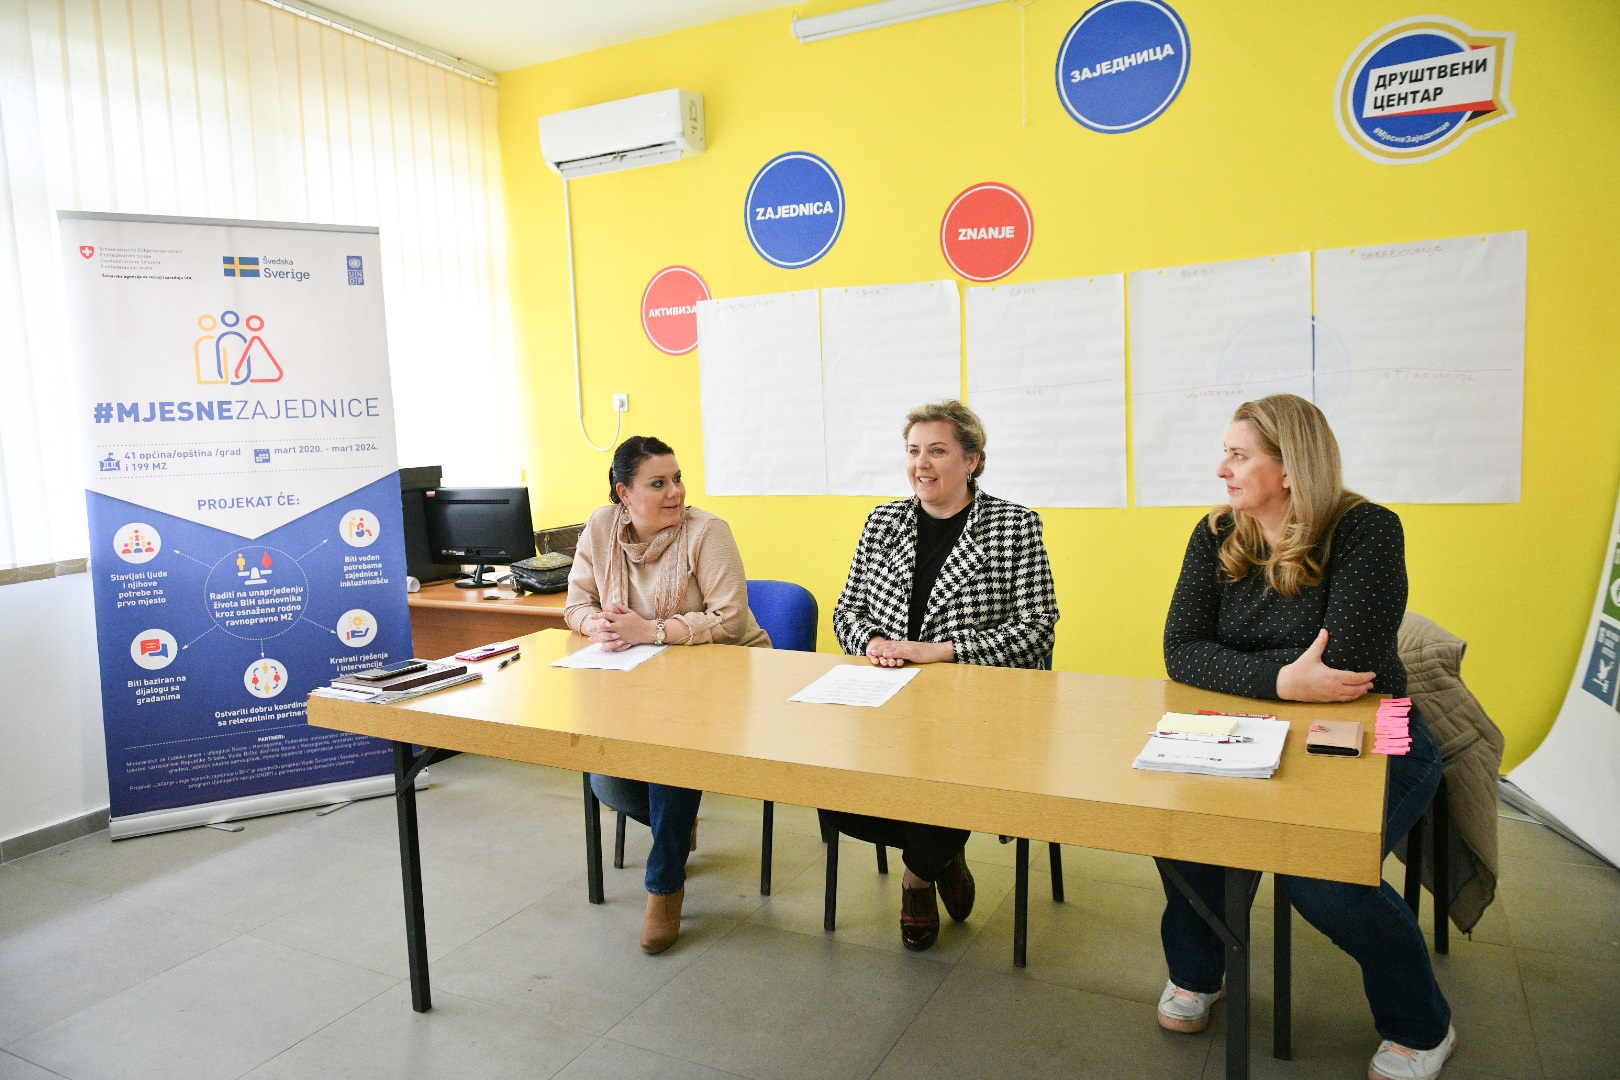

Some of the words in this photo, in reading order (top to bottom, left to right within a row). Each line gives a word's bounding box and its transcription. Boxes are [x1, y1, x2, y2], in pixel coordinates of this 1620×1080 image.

[1070, 43, 1175, 83] ЗАЈЕДНИЦА
[1374, 57, 1488, 91] ДРУШТВЕНИ
[1373, 87, 1444, 112] ЦЕНТАР
[755, 200, 834, 221] ZAJEDNICA
[957, 225, 1015, 241] ZNANJE
[262, 255, 294, 266] Švedska
[263, 268, 311, 282] Sverige
[93, 397, 380, 424] #MJESNEZAJEDNICE
[124, 451, 136, 460] 41
[139, 449, 213, 461] općina/opština
[214, 447, 242, 458] /grad
[274, 446, 296, 454] mart
[299, 445, 323, 454] 2020.
[331, 444, 353, 453] mart
[355, 443, 379, 452] 2024.
[131, 463, 149, 471] 199
[152, 462, 168, 471] MZ
[197, 495, 273, 511] PROJEKAT
[277, 491, 300, 507] ĆE:
[358, 554, 380, 562] vođen
[343, 563, 382, 572] potrebama
[110, 572, 146, 582] Stavljati
[147, 571, 168, 580] ljude
[345, 571, 378, 580] zajednice
[127, 580, 158, 590] njihove
[340, 577, 389, 588] inkluzivnošću
[118, 589, 151, 599] potrebe
[209, 591, 235, 600] Raditi
[249, 585, 304, 597] unaprjeđenju
[117, 600, 137, 609] prvo
[138, 597, 167, 607] mjesto
[213, 600, 239, 609] života
[257, 595, 302, 605] stanovnika
[215, 610, 235, 618] kroz
[236, 606, 276, 616] osnažene
[277, 604, 302, 612] rodno
[225, 615, 279, 626] ravnopravne
[280, 612, 293, 621] MZ
[329, 655, 358, 665] Kreirati
[359, 652, 389, 662] rješenja
[340, 660, 383, 672] intervencije
[127, 679, 142, 688] Biti
[144, 676, 175, 686] baziran
[135, 686, 169, 697] dijalogu
[136, 694, 181, 705] građanima
[214, 708, 248, 719] Ostvariti
[250, 705, 273, 714] dobru
[228, 714, 275, 726] relevantnim
